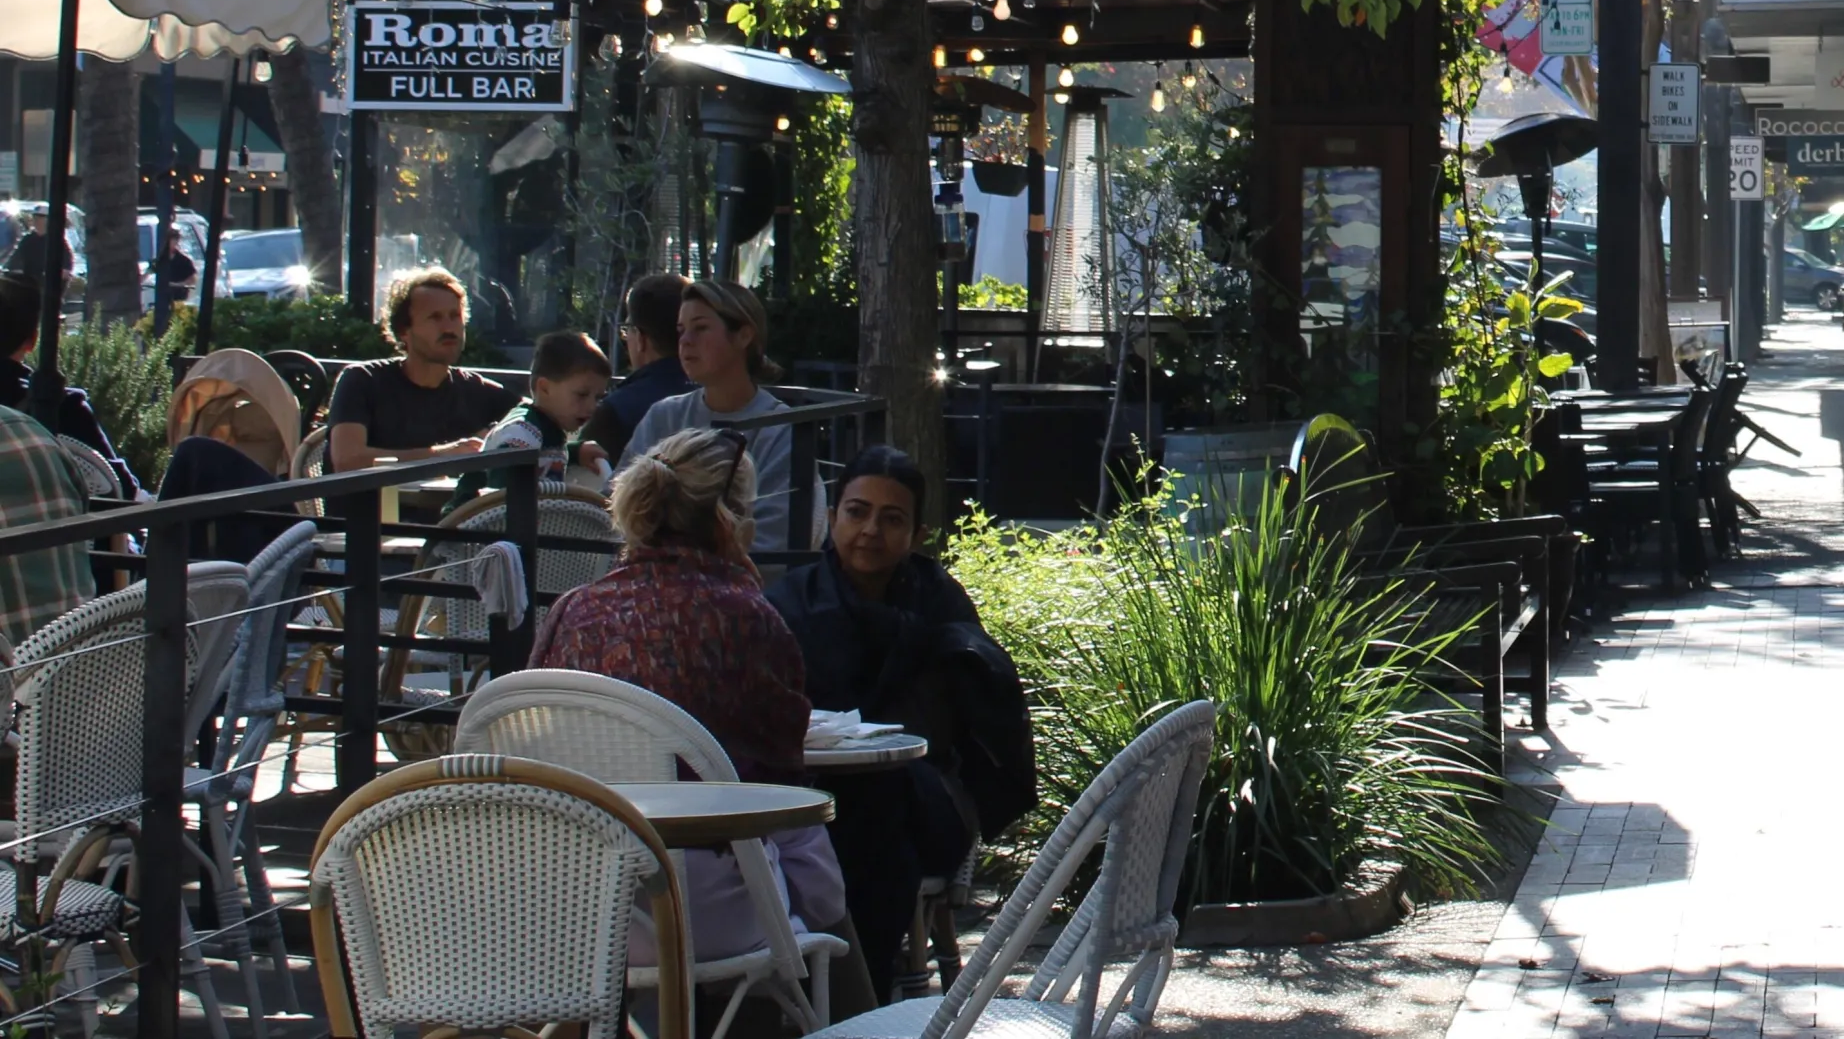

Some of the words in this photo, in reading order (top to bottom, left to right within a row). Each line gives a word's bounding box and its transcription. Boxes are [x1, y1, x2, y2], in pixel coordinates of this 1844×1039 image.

[363, 13, 560, 48] Roma
[362, 50, 457, 66] ITALIAN
[464, 51, 561, 67] CUISINE
[1662, 70, 1685, 82] WALK
[390, 75, 463, 99] FULL
[471, 76, 534, 99] BAR
[1661, 85, 1685, 97] BIKES
[1667, 100, 1679, 112] ON
[1651, 115, 1693, 127] SIDEWALK
[1730, 144, 1760, 155] PEED
[1730, 158, 1755, 167] IMIT
[1729, 169, 1758, 192] 20
